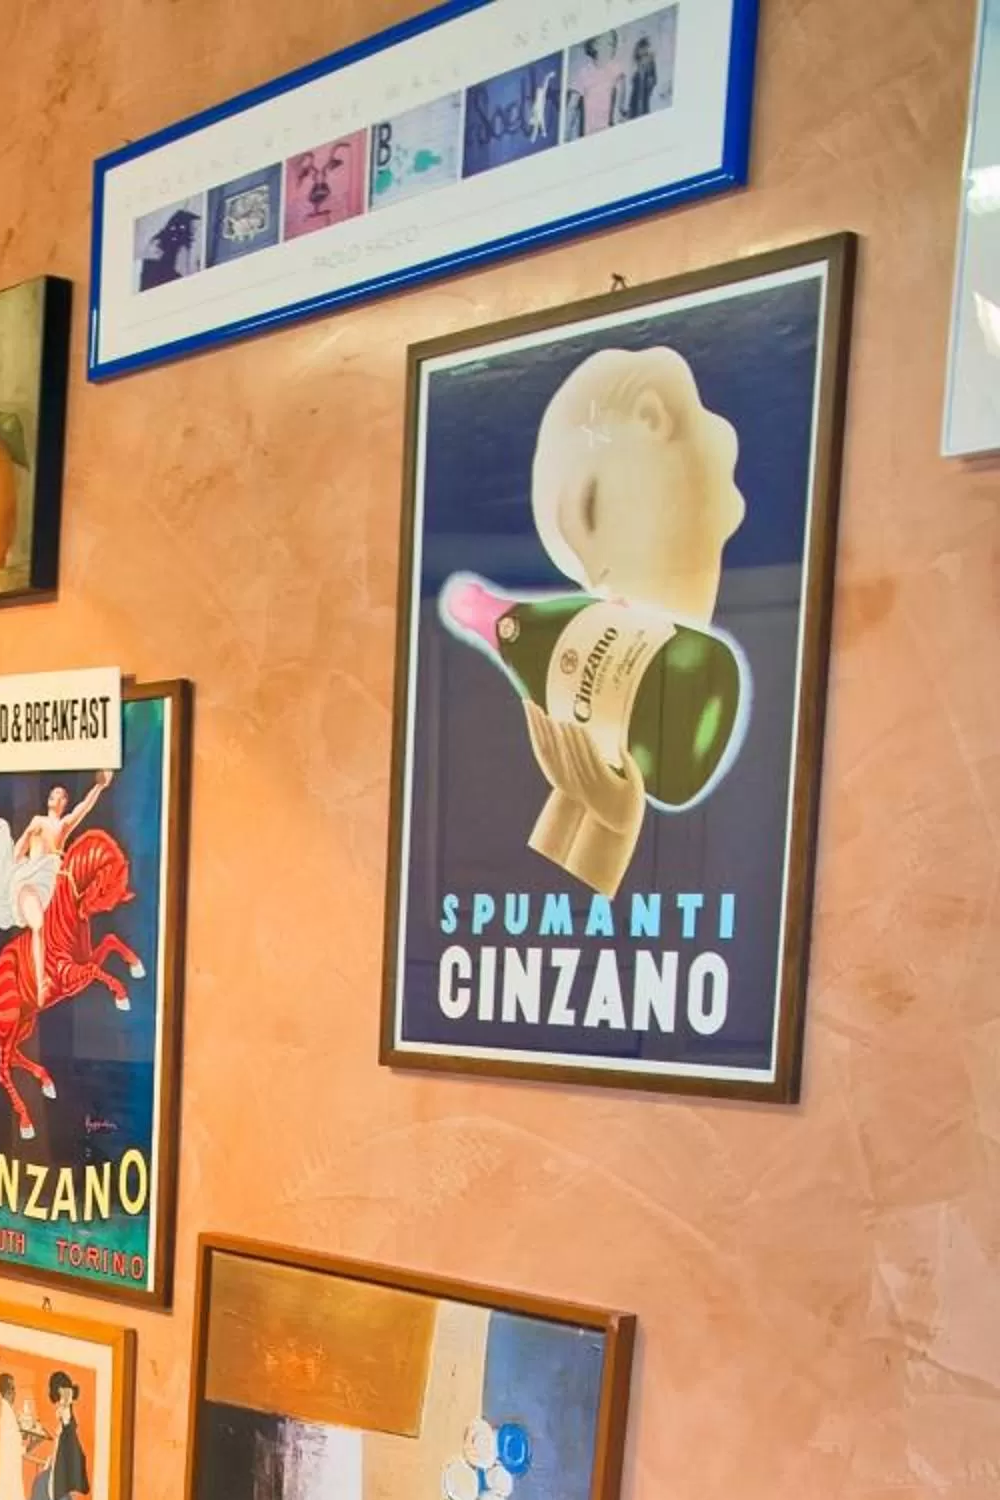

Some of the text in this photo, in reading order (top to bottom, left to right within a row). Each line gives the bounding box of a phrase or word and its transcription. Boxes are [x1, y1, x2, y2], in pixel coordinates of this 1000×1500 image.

[573, 627, 618, 723] Cinzano
[11, 703, 23, 743] &
[24, 695, 111, 743] BREAKFAST
[440, 892, 736, 939] SPUMANTI
[437, 945, 729, 1036] CINZANO
[55, 1238, 145, 1280] TORINO
